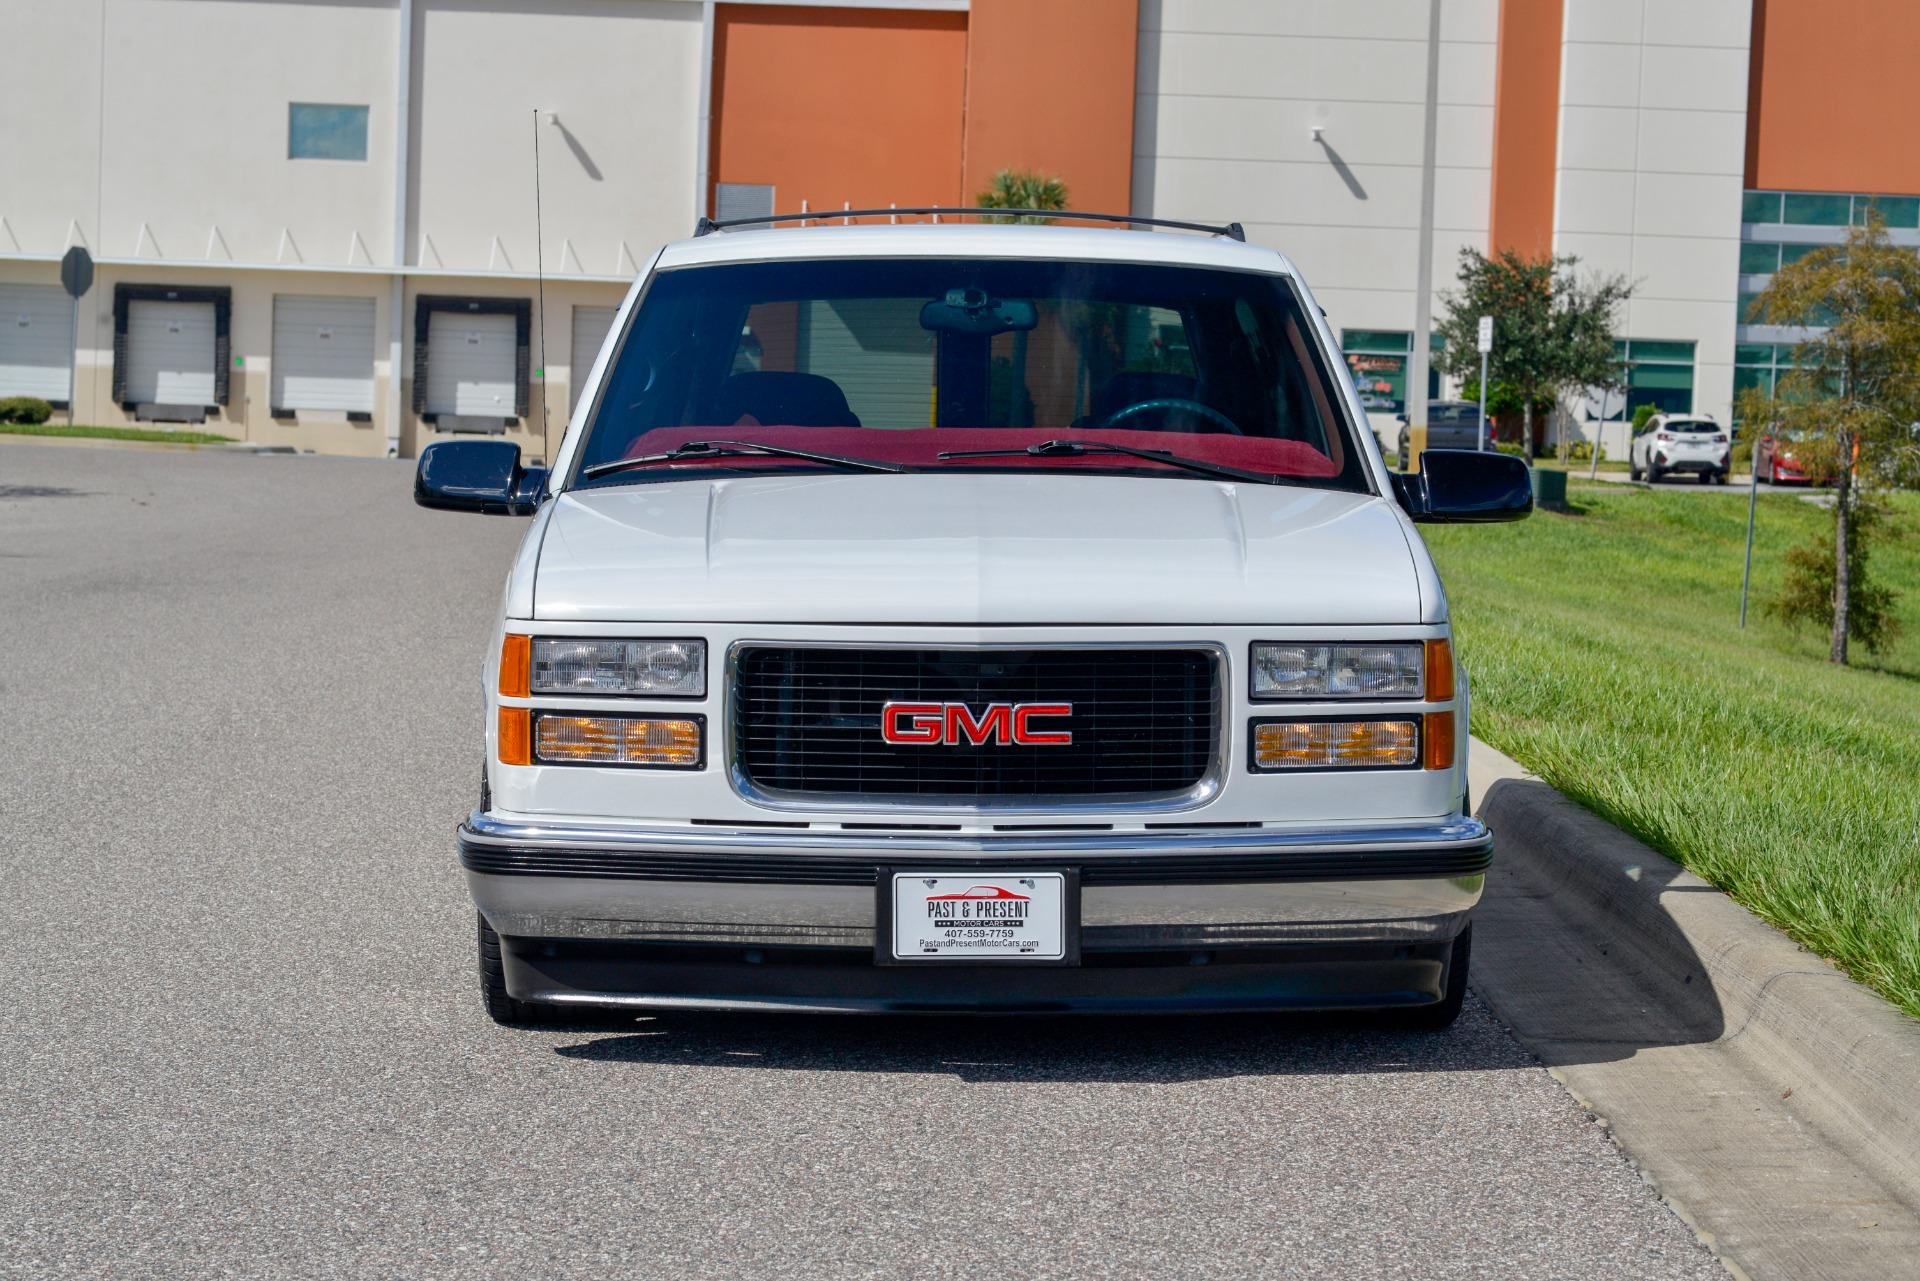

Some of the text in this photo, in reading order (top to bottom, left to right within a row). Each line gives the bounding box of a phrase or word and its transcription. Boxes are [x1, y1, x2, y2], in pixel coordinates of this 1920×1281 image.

[881, 702, 1072, 745] GMC
[927, 901, 1030, 918] PAST & PRESENT
[944, 930, 1014, 938] 407-559-7759
[919, 939, 1039, 948] PastandPresentMotorCars.com
